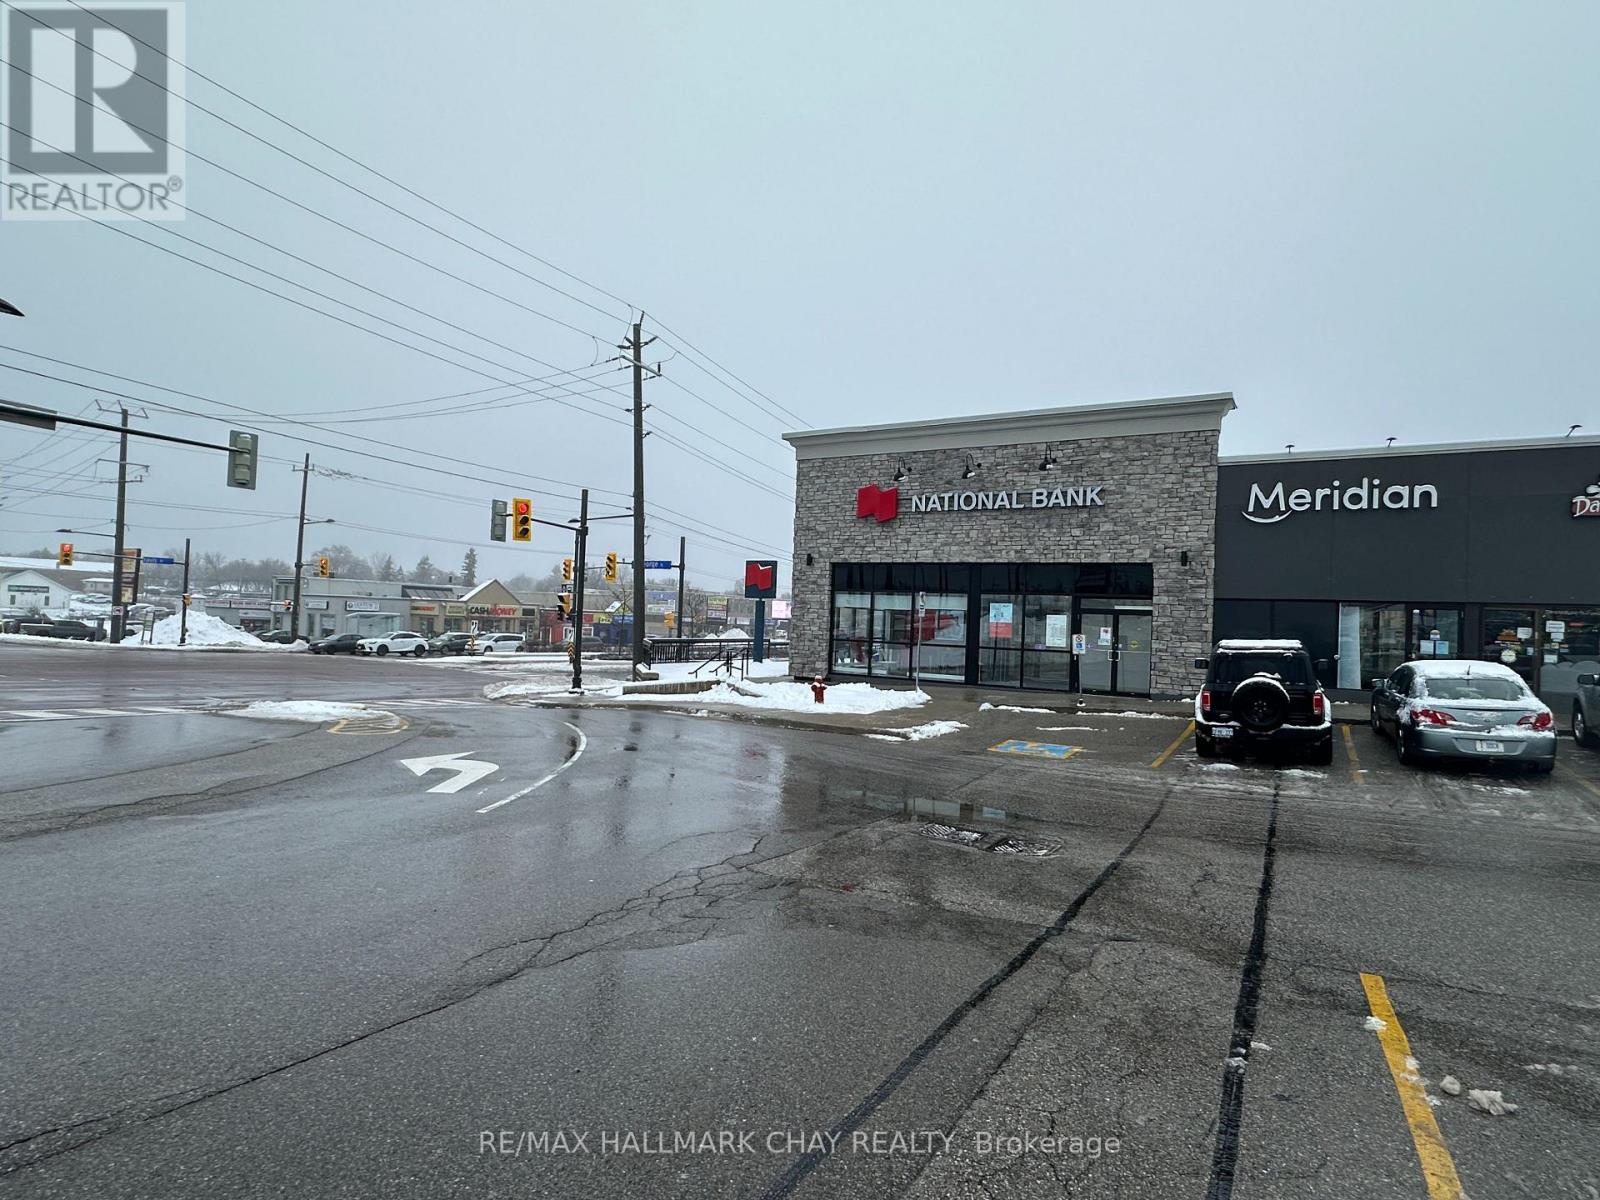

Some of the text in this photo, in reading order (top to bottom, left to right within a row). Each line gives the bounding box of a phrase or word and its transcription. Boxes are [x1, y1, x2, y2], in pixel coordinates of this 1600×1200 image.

[911, 486, 1105, 512] NATIONAL BANK
[1247, 477, 1438, 513] Meridian
